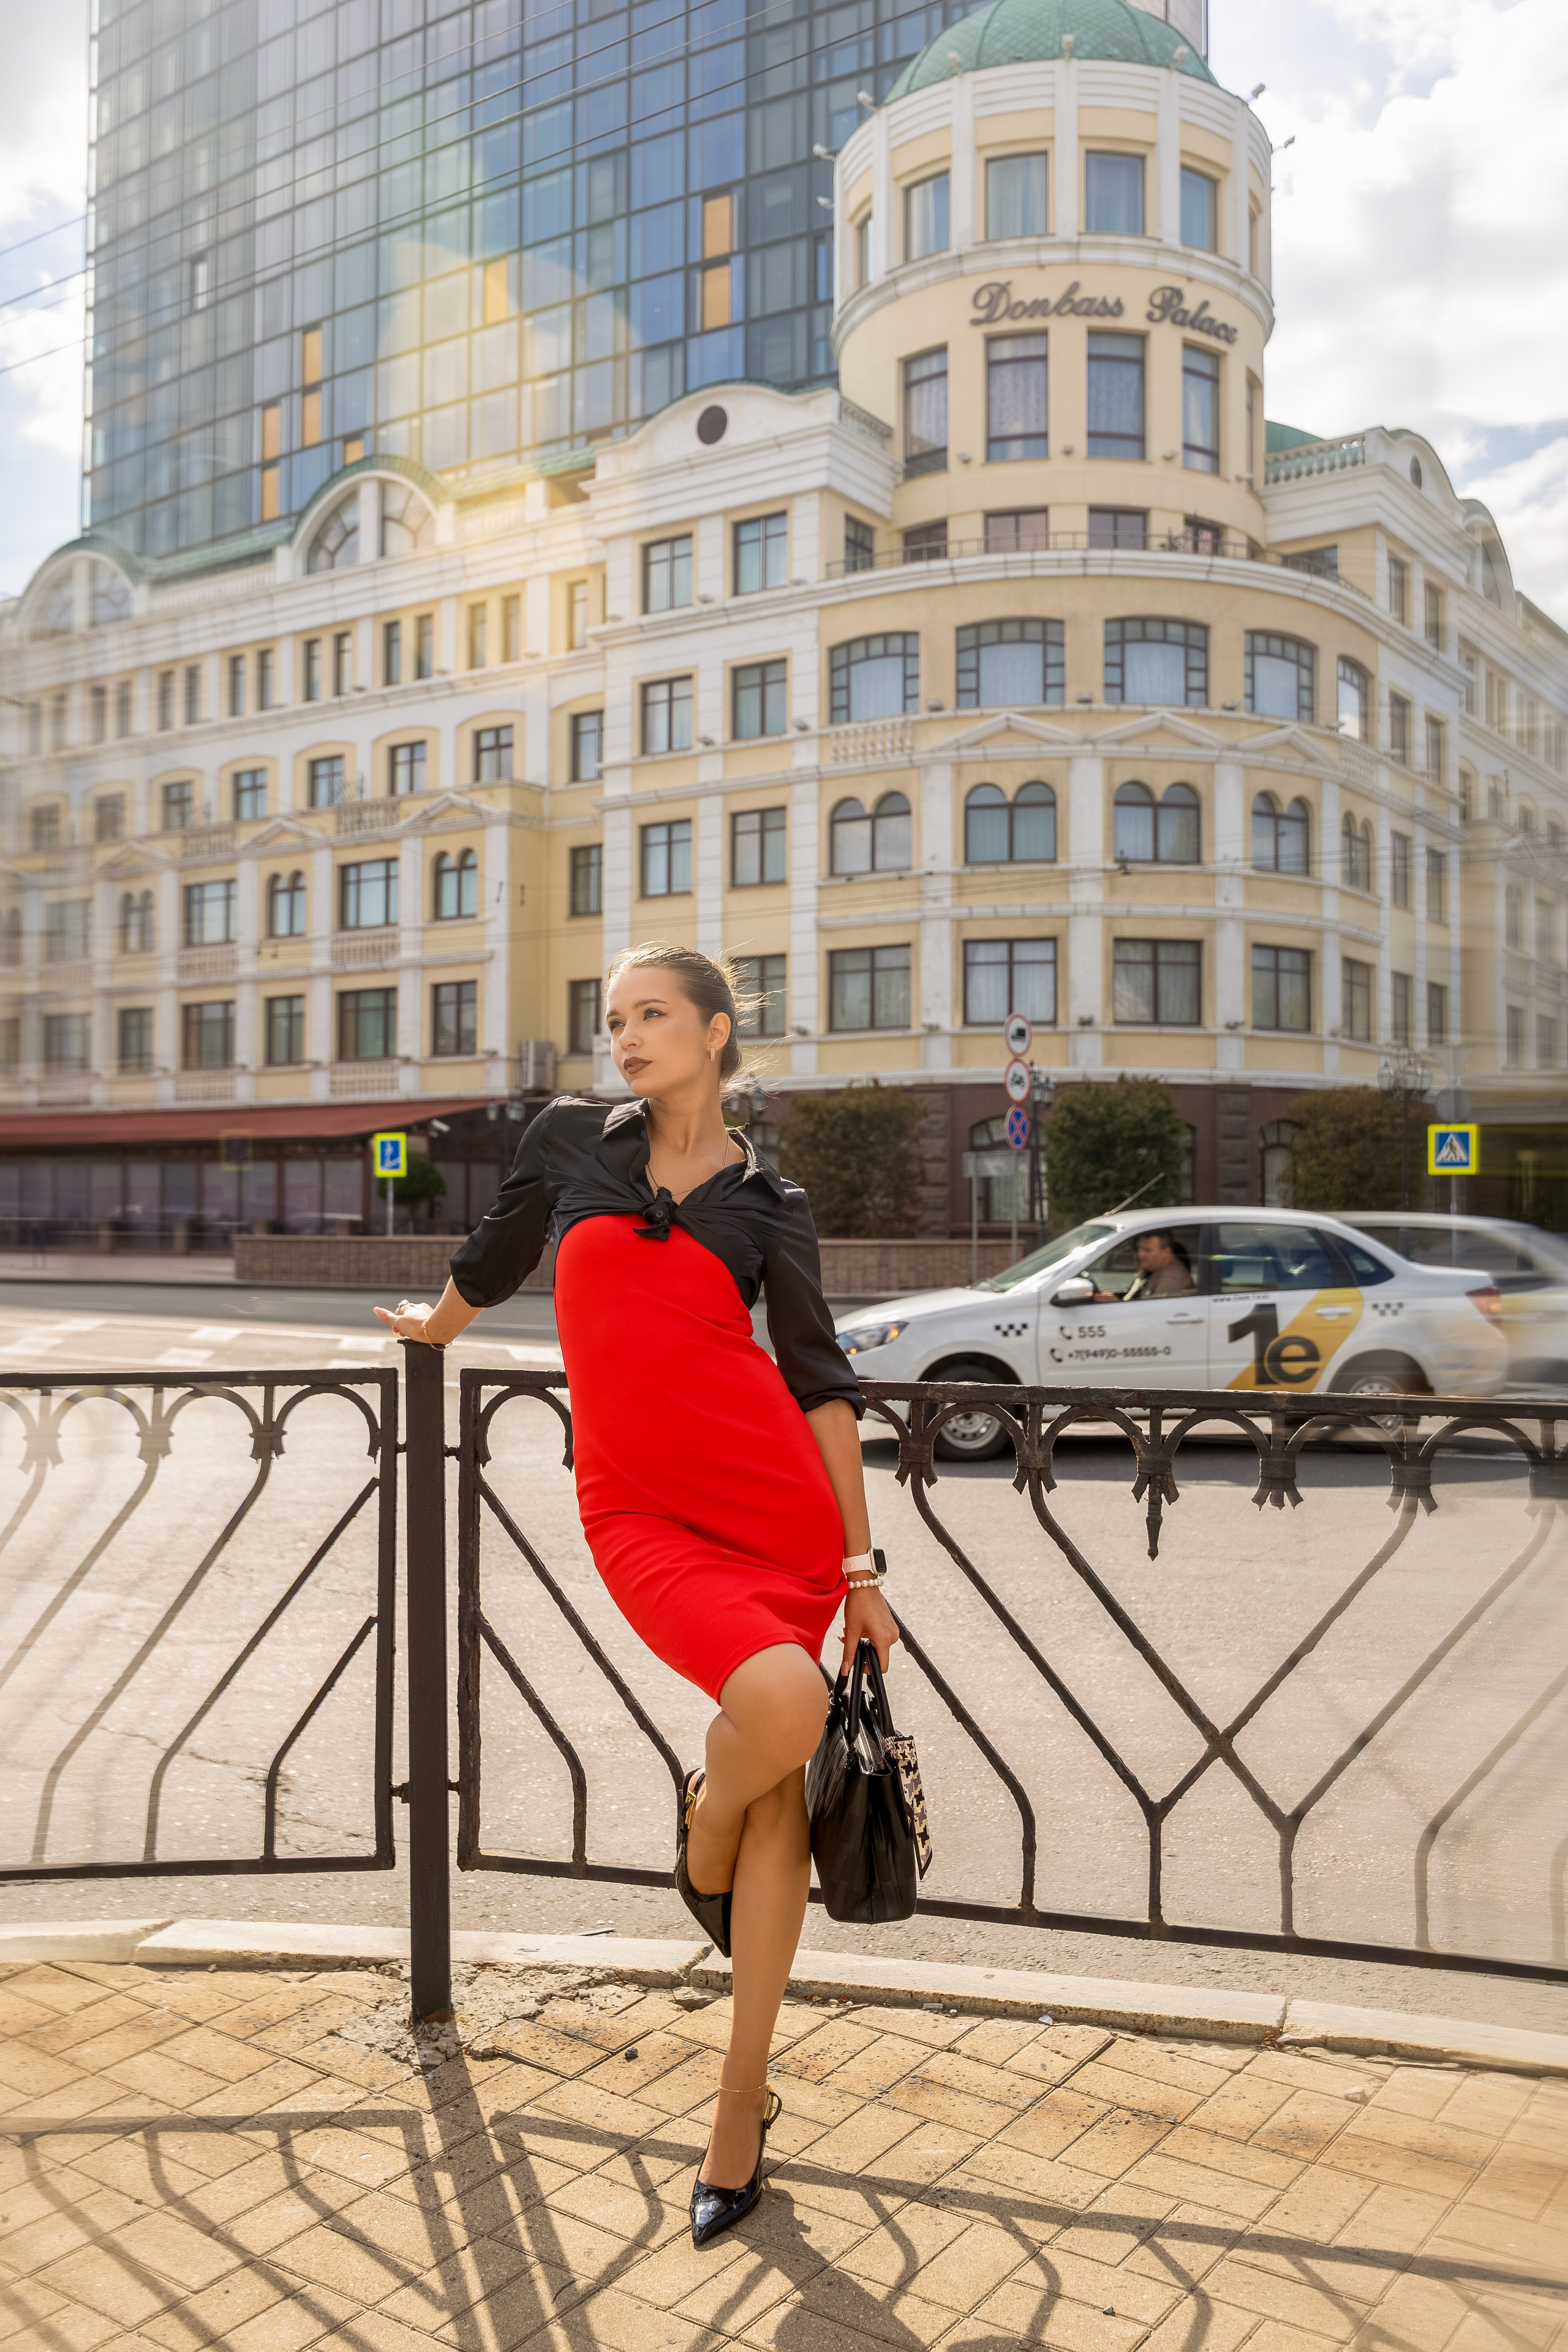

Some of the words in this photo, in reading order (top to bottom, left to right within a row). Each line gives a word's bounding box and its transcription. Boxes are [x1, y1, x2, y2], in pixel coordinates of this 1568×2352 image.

[970, 281, 1125, 325] Donbass
[1147, 285, 1238, 344] Palace
[1078, 1325, 1106, 1338] 555
